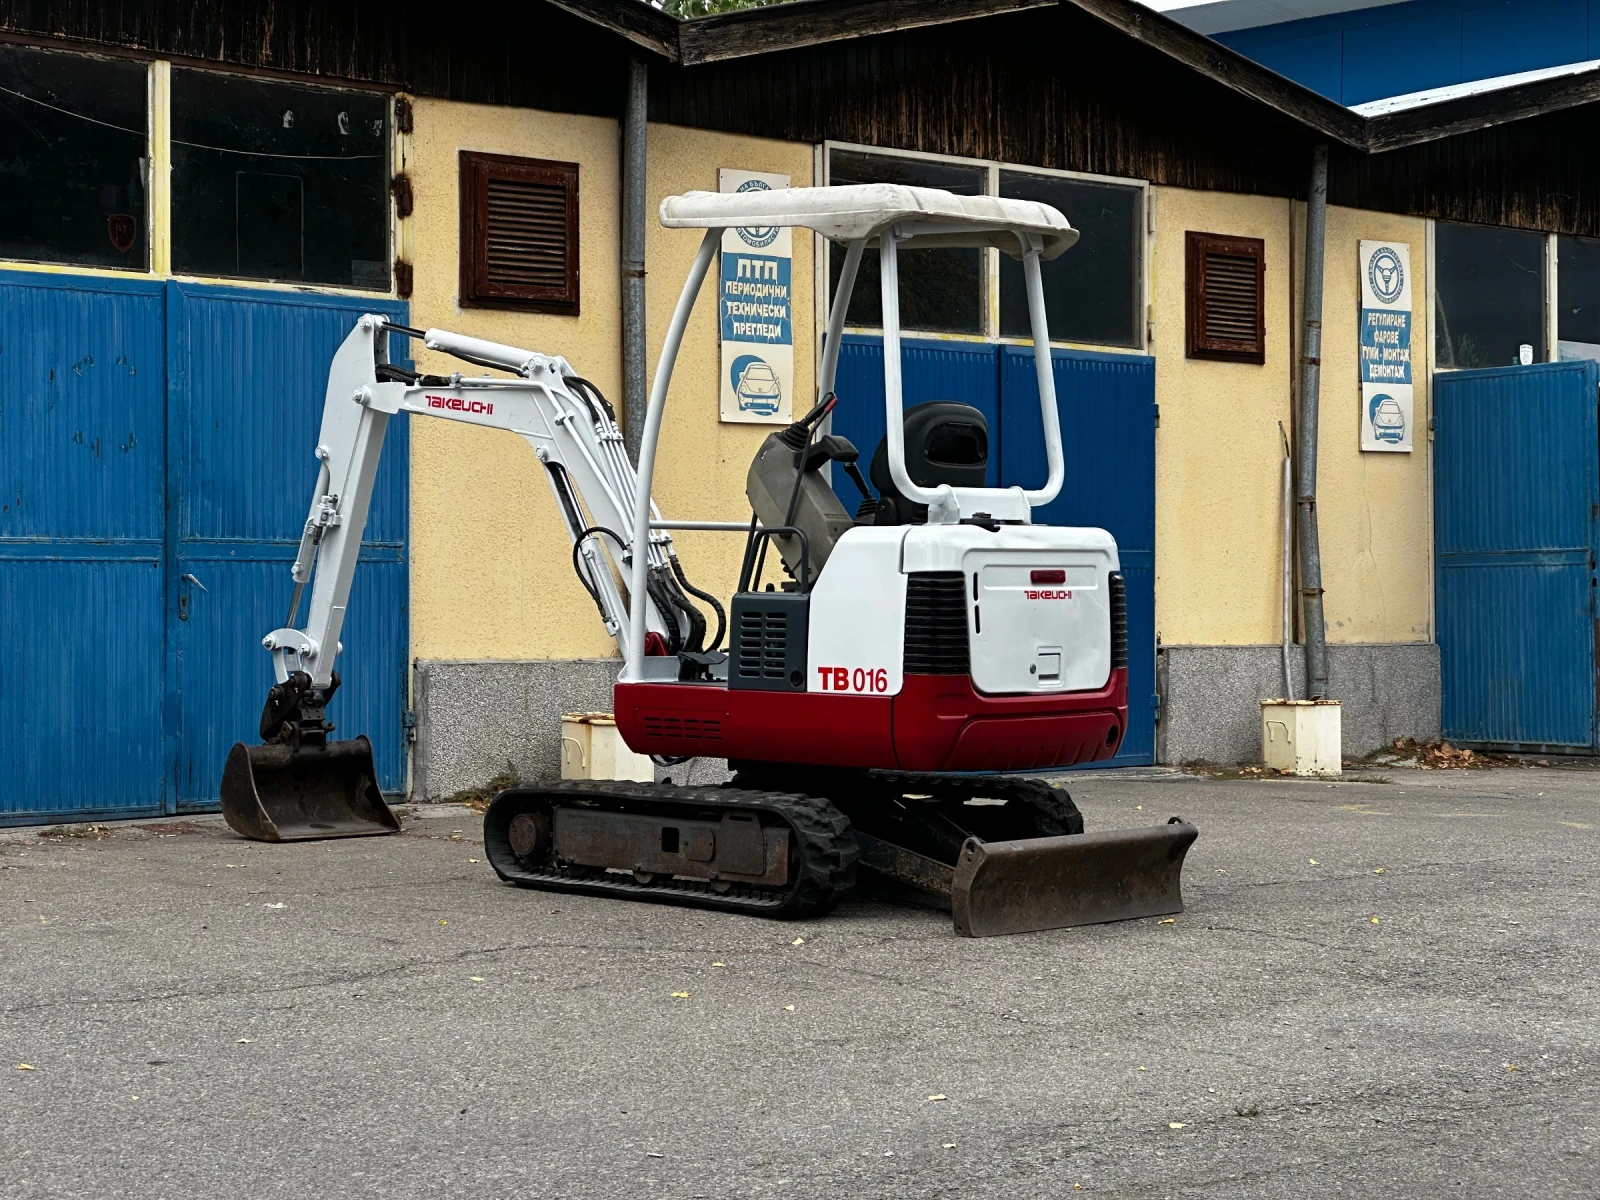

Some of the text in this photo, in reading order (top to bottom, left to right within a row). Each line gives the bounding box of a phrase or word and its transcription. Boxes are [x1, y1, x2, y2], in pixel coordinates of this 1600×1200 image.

[737, 258, 778, 280] ПТП
[725, 281, 787, 298] ПЕРИОДИЧНИ
[726, 301, 787, 318] ТЕХНИЧЕСКИ
[1368, 312, 1406, 328] РЕГУЛИРАНЕ
[733, 321, 782, 338] ПРЕГЛЕДИ
[1373, 330, 1399, 344] ФАРОВЕ
[1369, 363, 1405, 380] ДЕМОНТАЖ
[425, 395, 493, 415] TAKEUCHI
[1024, 590, 1072, 600] TAKEUCHI
